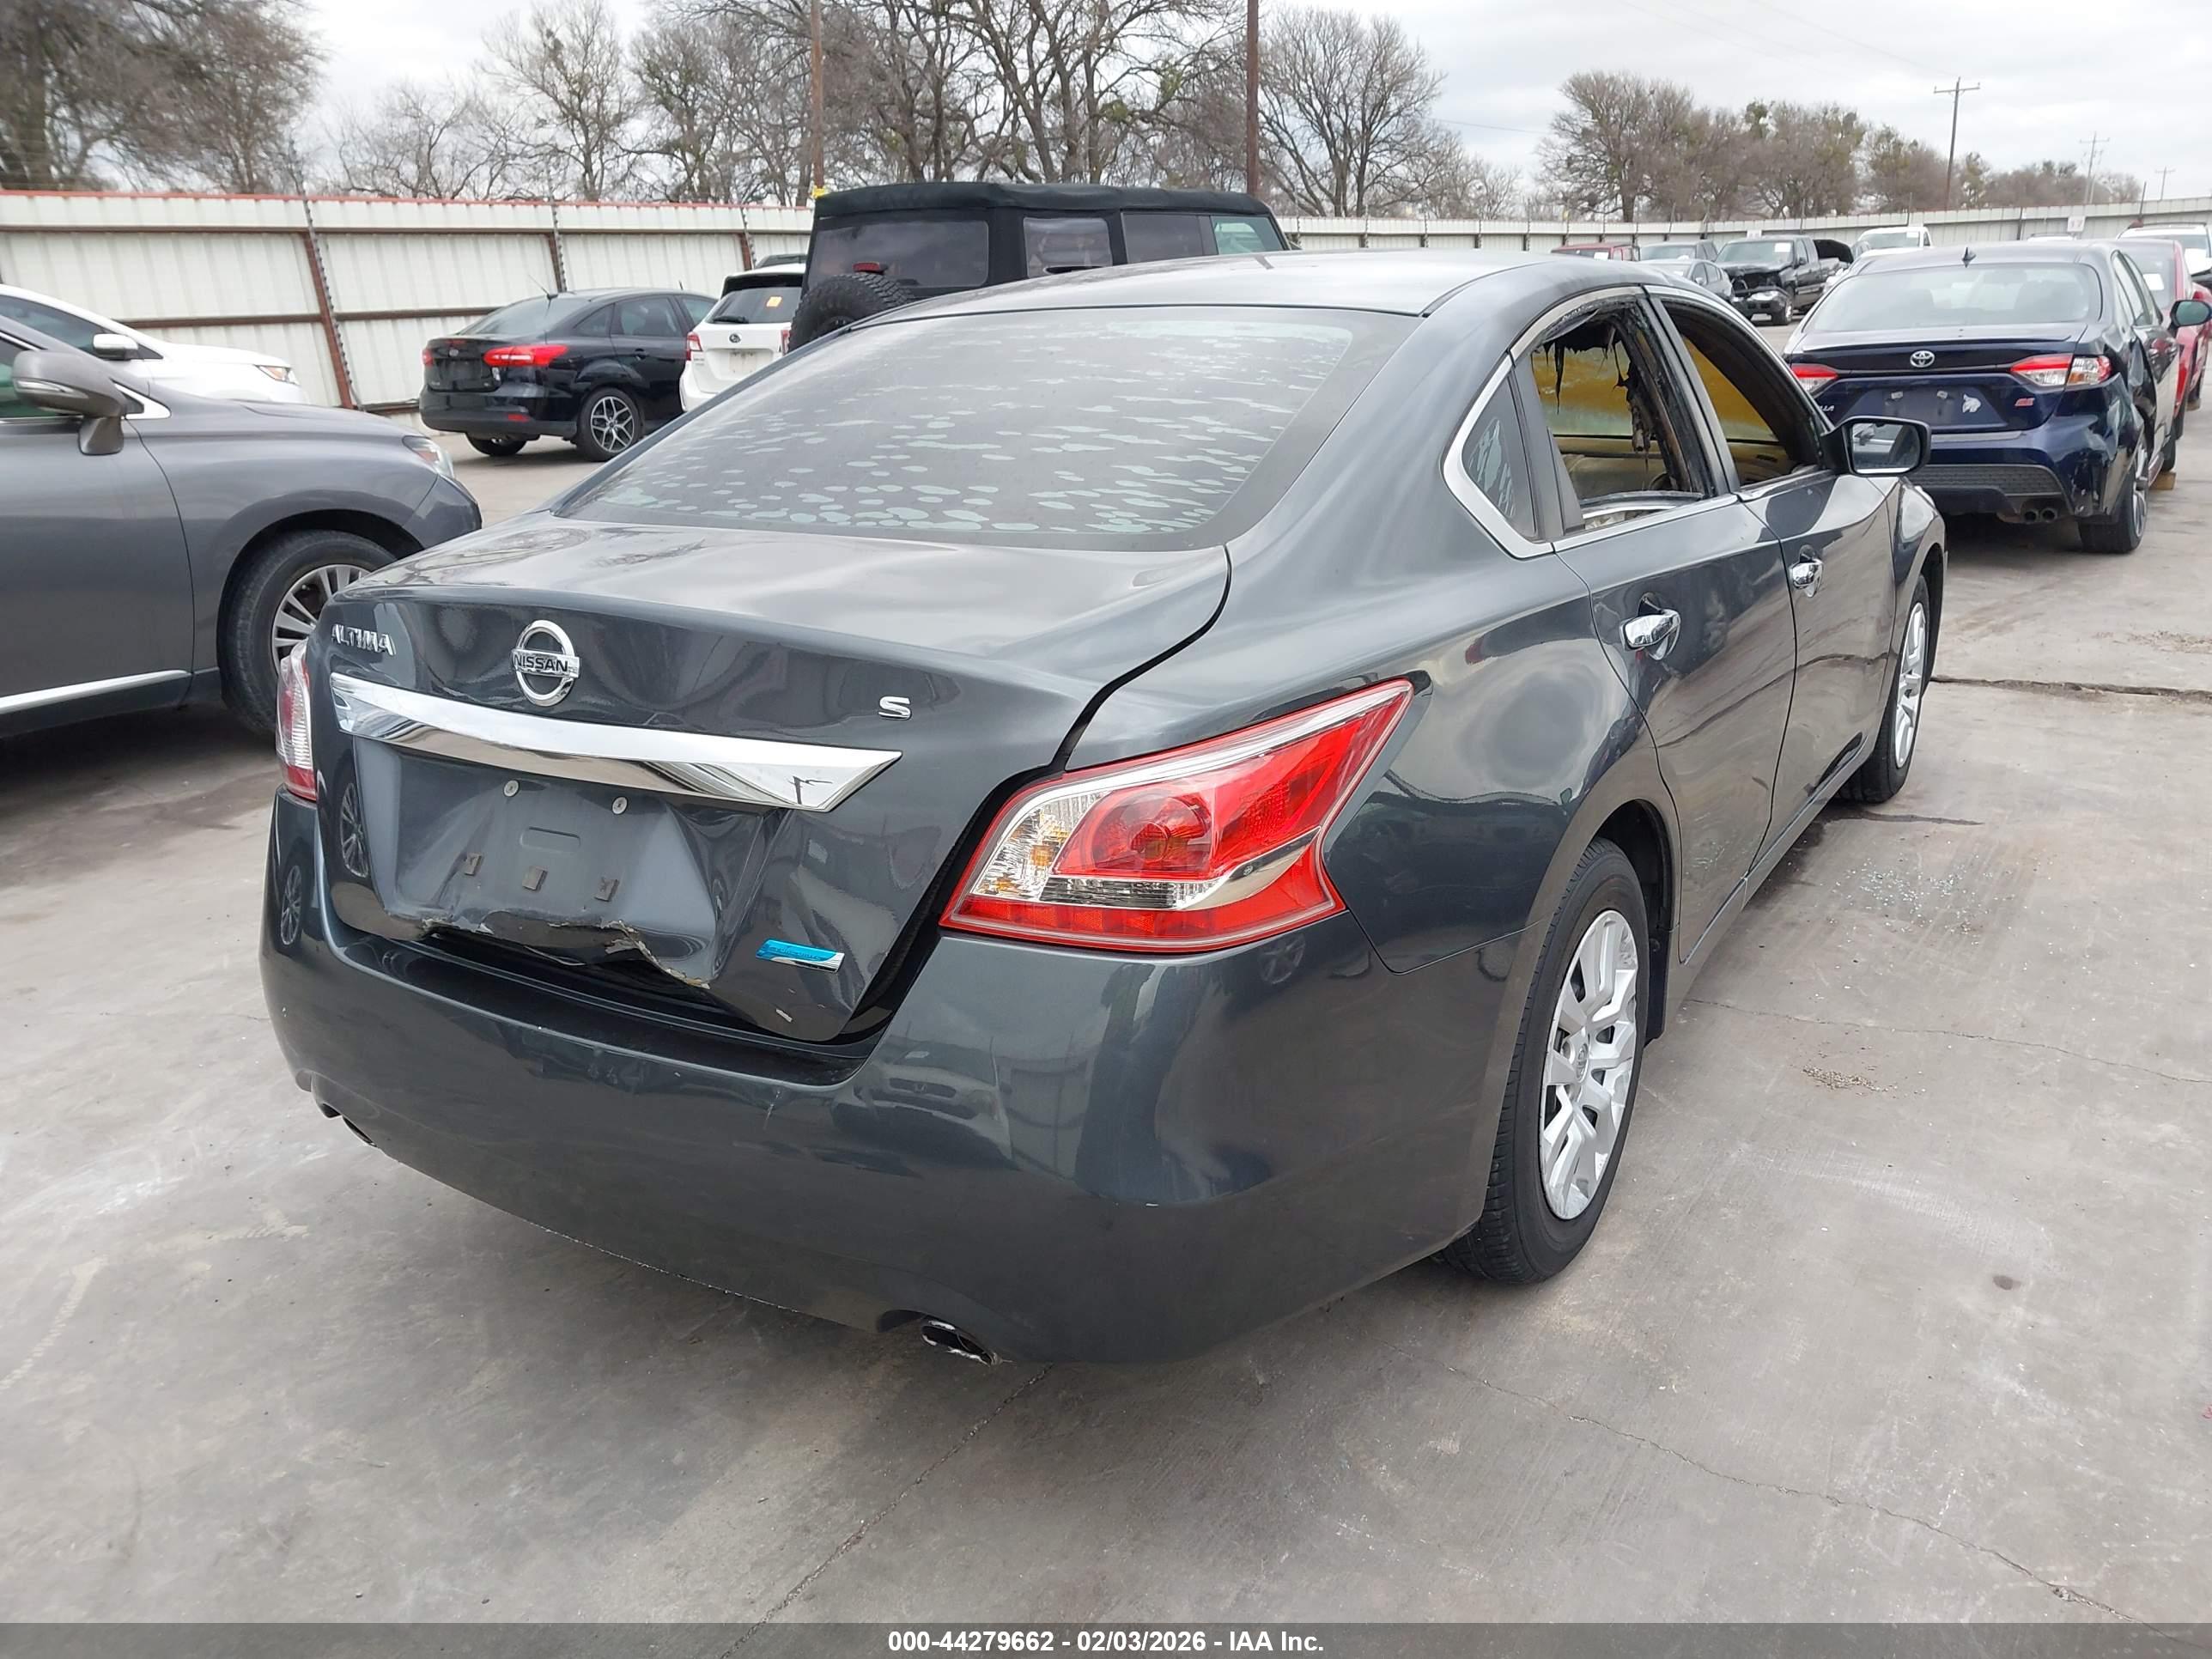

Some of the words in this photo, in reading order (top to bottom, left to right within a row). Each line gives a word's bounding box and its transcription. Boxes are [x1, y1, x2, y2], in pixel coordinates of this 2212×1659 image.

[331, 623, 397, 656] ALTIMA
[514, 653, 568, 672] NISSAN
[878, 696, 911, 719] S
